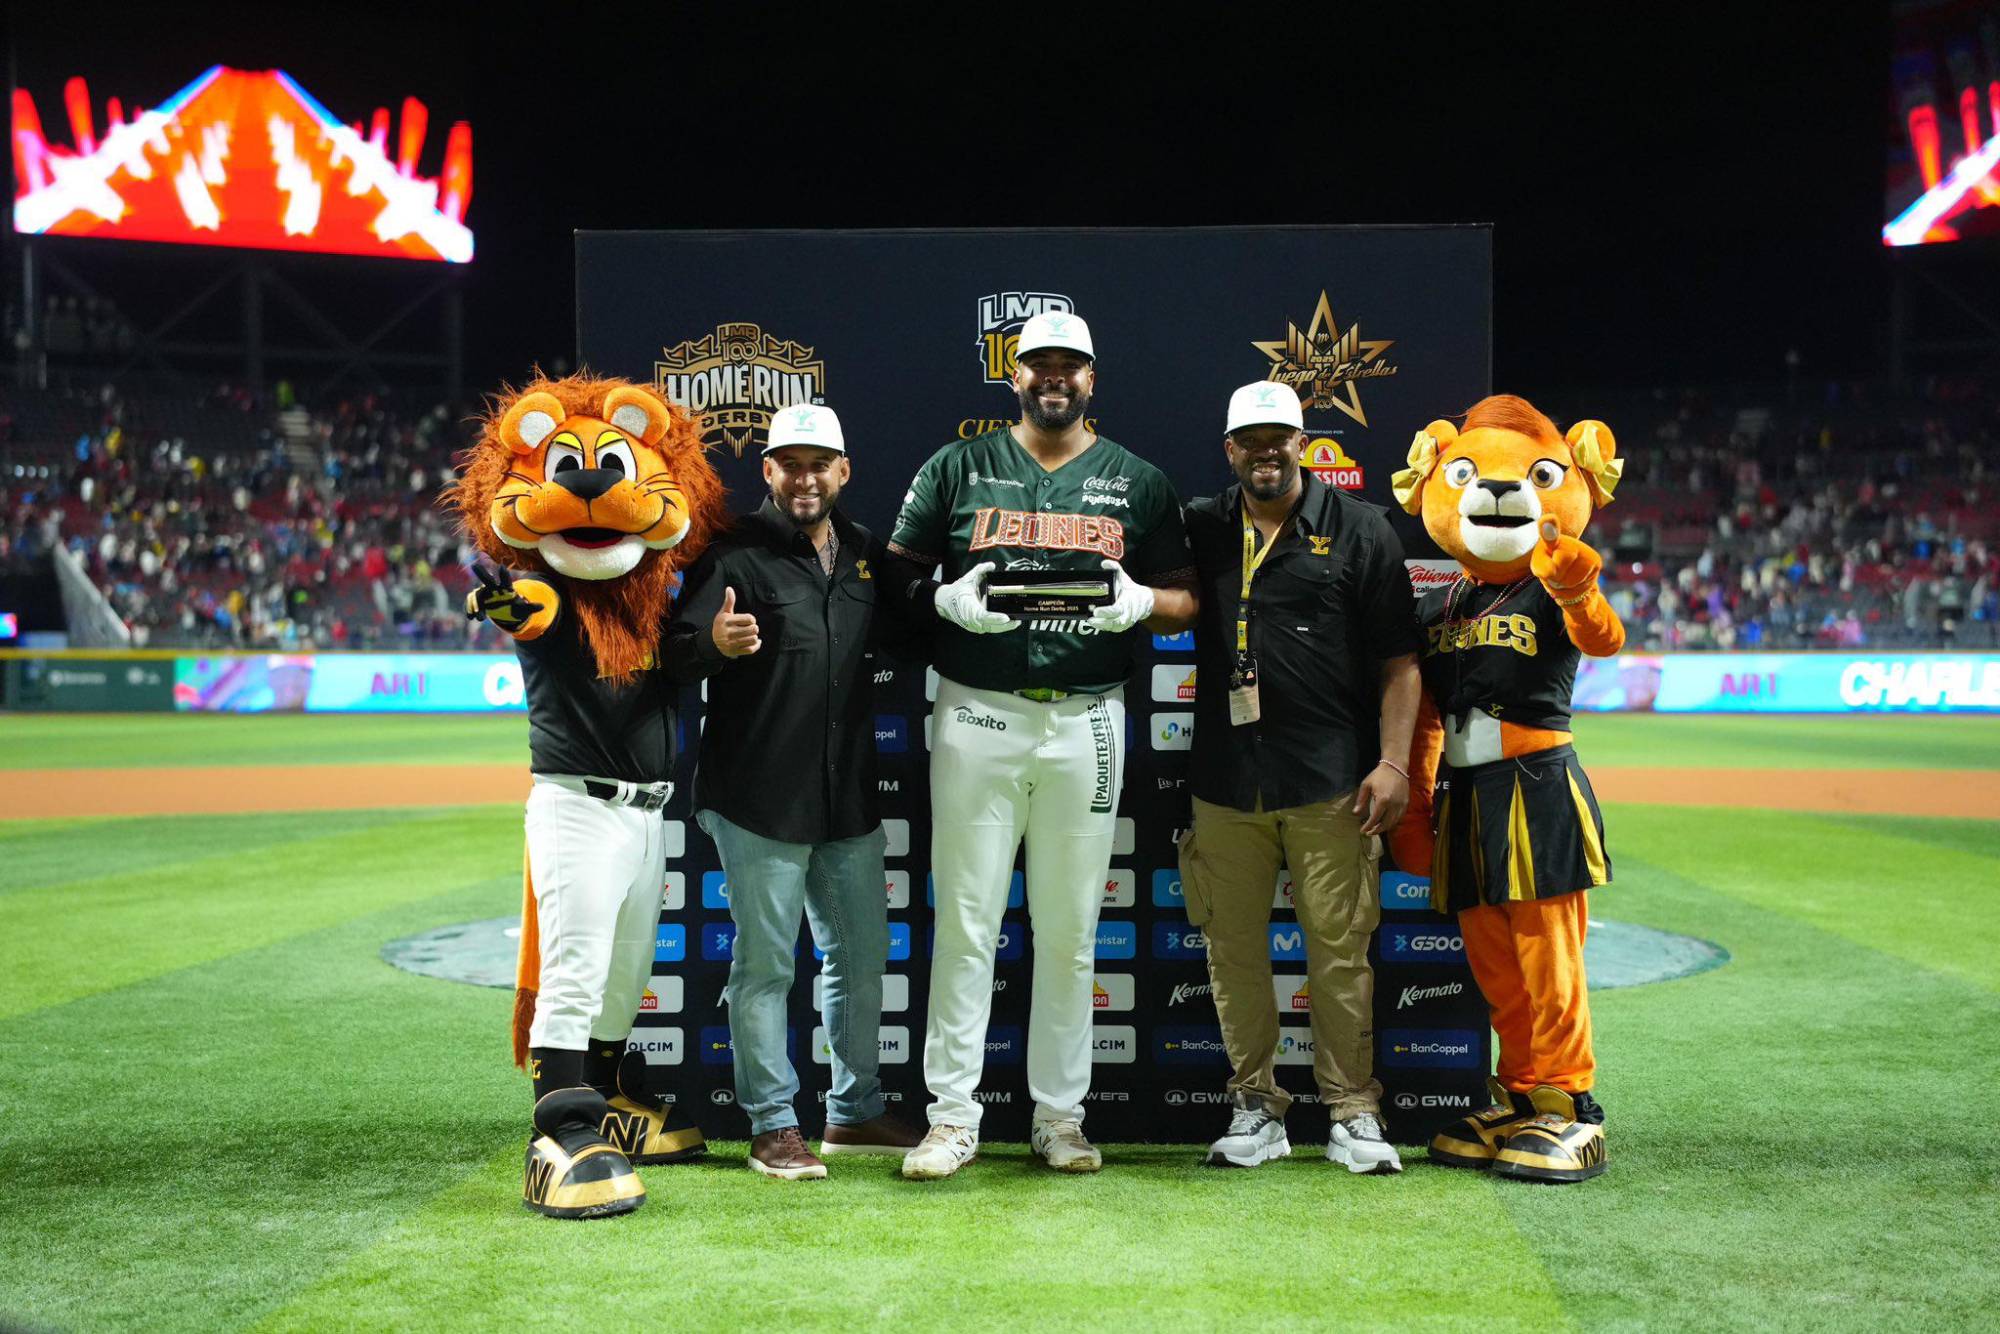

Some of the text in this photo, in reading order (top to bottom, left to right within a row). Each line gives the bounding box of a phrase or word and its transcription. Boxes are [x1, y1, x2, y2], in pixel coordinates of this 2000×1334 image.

[667, 364, 814, 411] HOME RUN
[969, 507, 1124, 560] LEONES
[957, 711, 1007, 732] Boxito
[1397, 982, 1463, 1010] Kermato
[1411, 1043, 1468, 1056] BanCoppel
[1421, 1096, 1470, 1107] GWM
